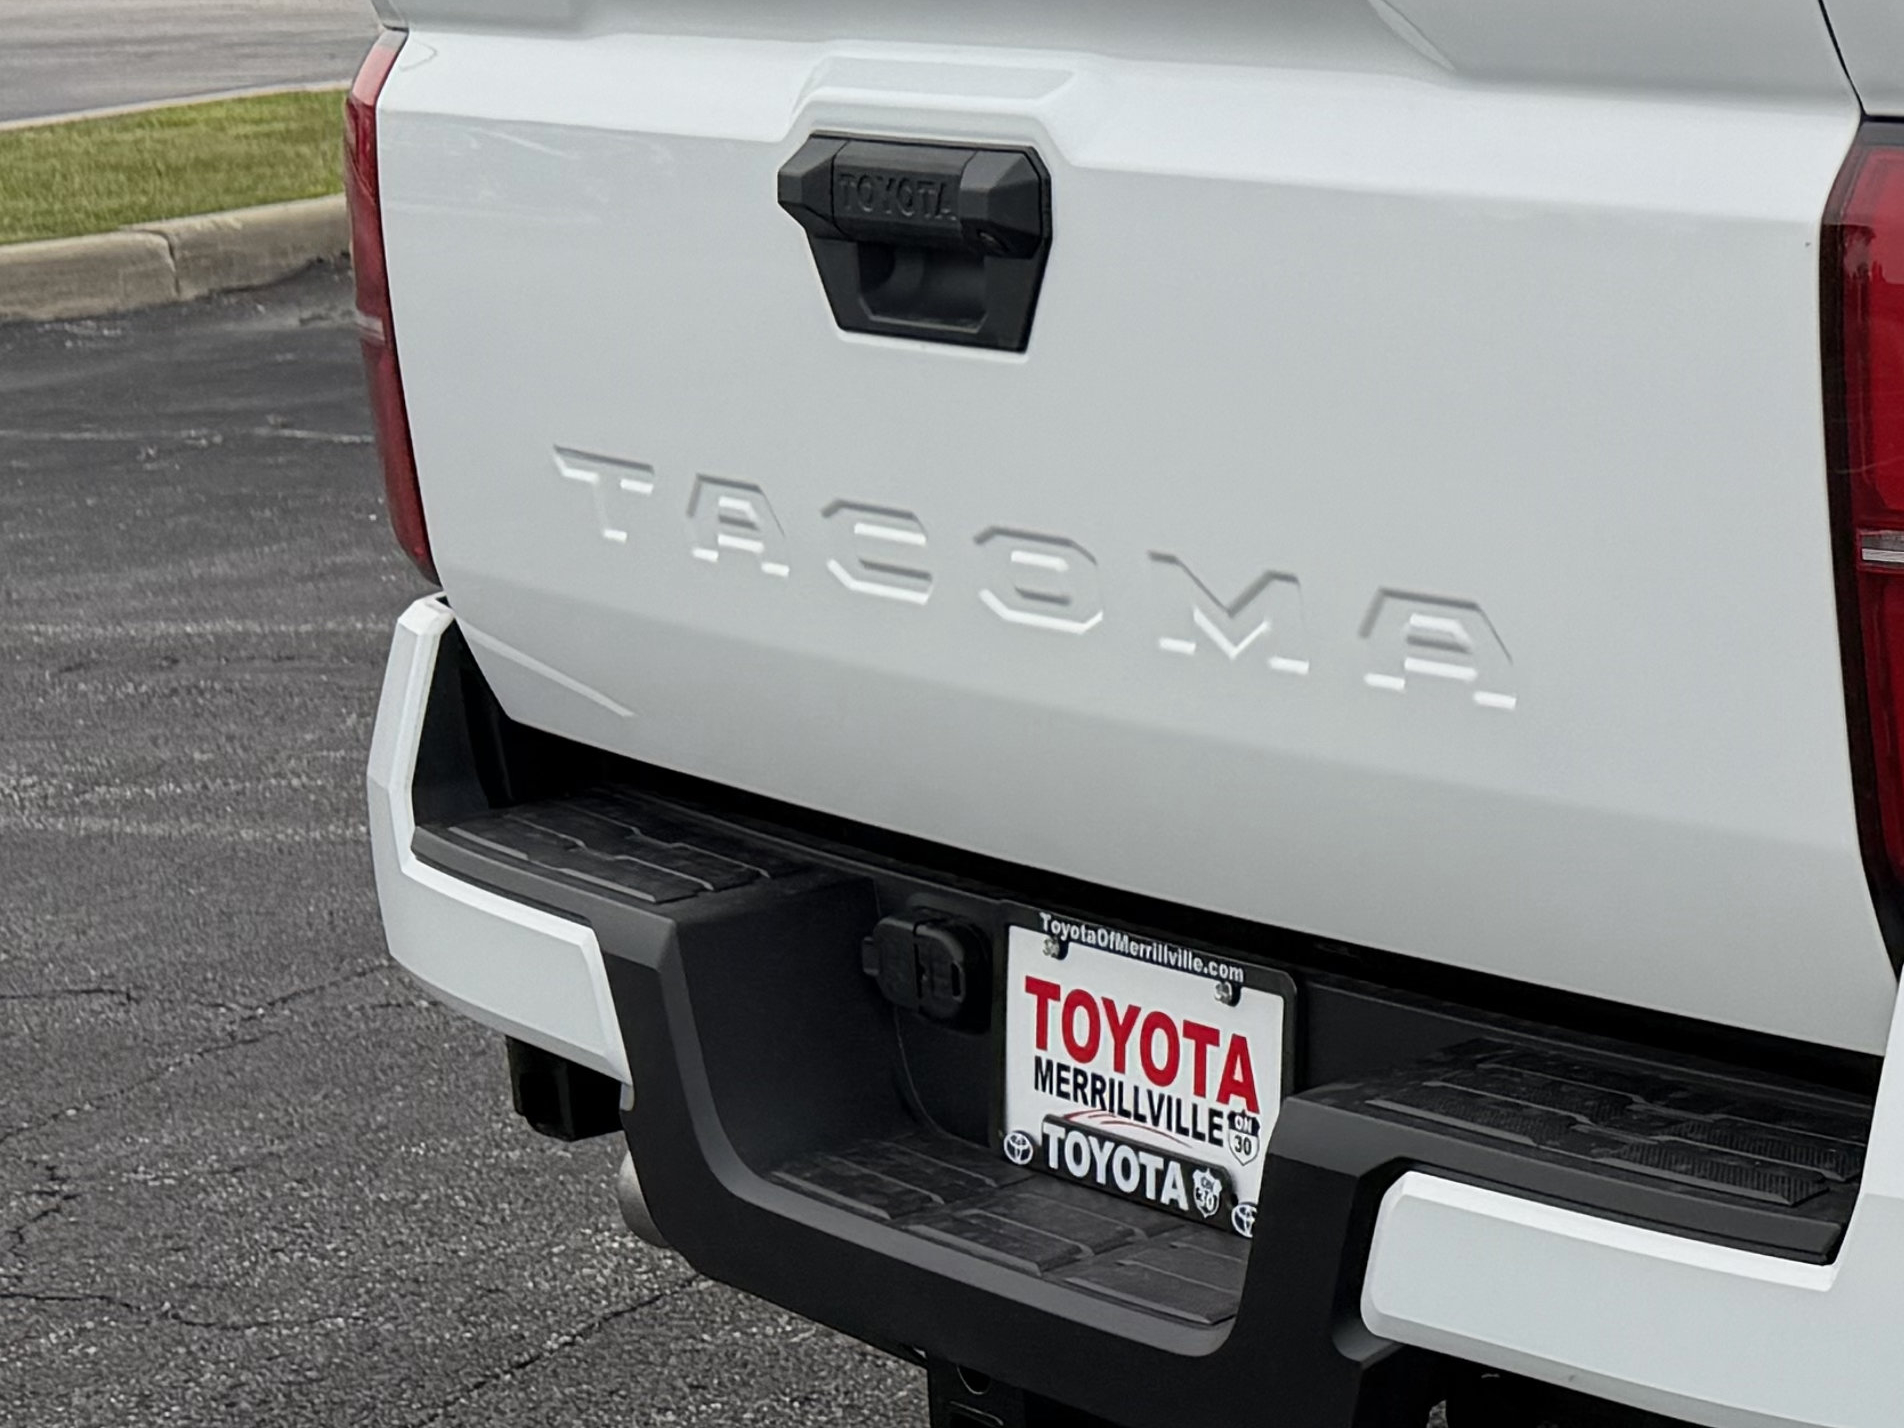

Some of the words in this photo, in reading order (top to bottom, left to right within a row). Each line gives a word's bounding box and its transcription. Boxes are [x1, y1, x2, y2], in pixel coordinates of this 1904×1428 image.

[837, 172, 958, 222] TOYOTA
[552, 444, 1519, 711] TACOMA
[1039, 912, 1245, 983] ToyotaOfMerrillville.com
[1024, 976, 1261, 1114] TOYOTA
[1034, 1055, 1225, 1147] MERRILLVILLE
[1234, 1114, 1252, 1133] ON
[1043, 1122, 1189, 1212] TOYOTA
[1234, 1135, 1252, 1156] 30
